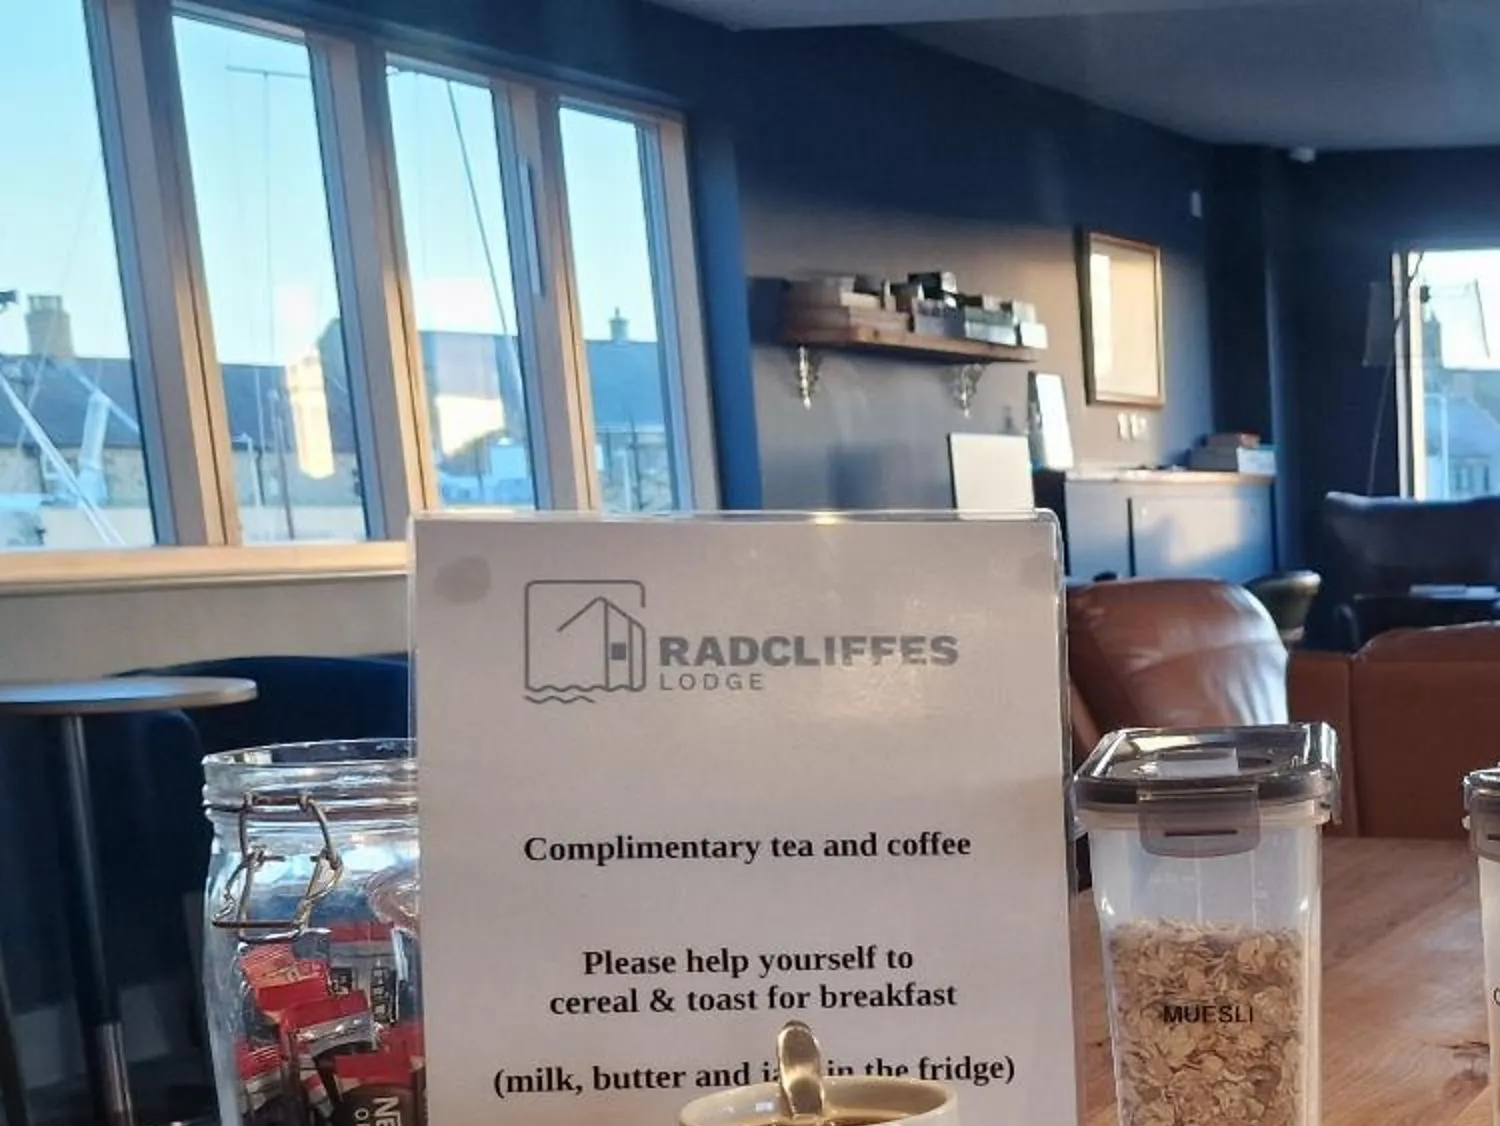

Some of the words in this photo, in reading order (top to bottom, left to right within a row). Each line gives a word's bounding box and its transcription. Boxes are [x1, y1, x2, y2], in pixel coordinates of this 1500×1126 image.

[658, 635, 959, 668] RADCLIFFES
[659, 672, 764, 691] LODGE
[523, 834, 761, 867] Complimentary
[770, 837, 815, 858] tea
[823, 832, 878, 857] and
[887, 831, 972, 857] coffee
[582, 949, 677, 975] Please
[686, 947, 749, 979] help
[758, 944, 877, 979] yourself
[887, 948, 914, 969] to
[549, 987, 639, 1015] cereal
[649, 989, 675, 1013] &
[687, 988, 757, 1012] toast
[767, 984, 811, 1009] for
[819, 980, 957, 1009] breakfast
[1163, 1005, 1253, 1024] MUESLI
[493, 1066, 583, 1099] (milk,
[592, 1065, 687, 1091] butter
[695, 1061, 750, 1087] and
[918, 1055, 1015, 1086] fridge)
